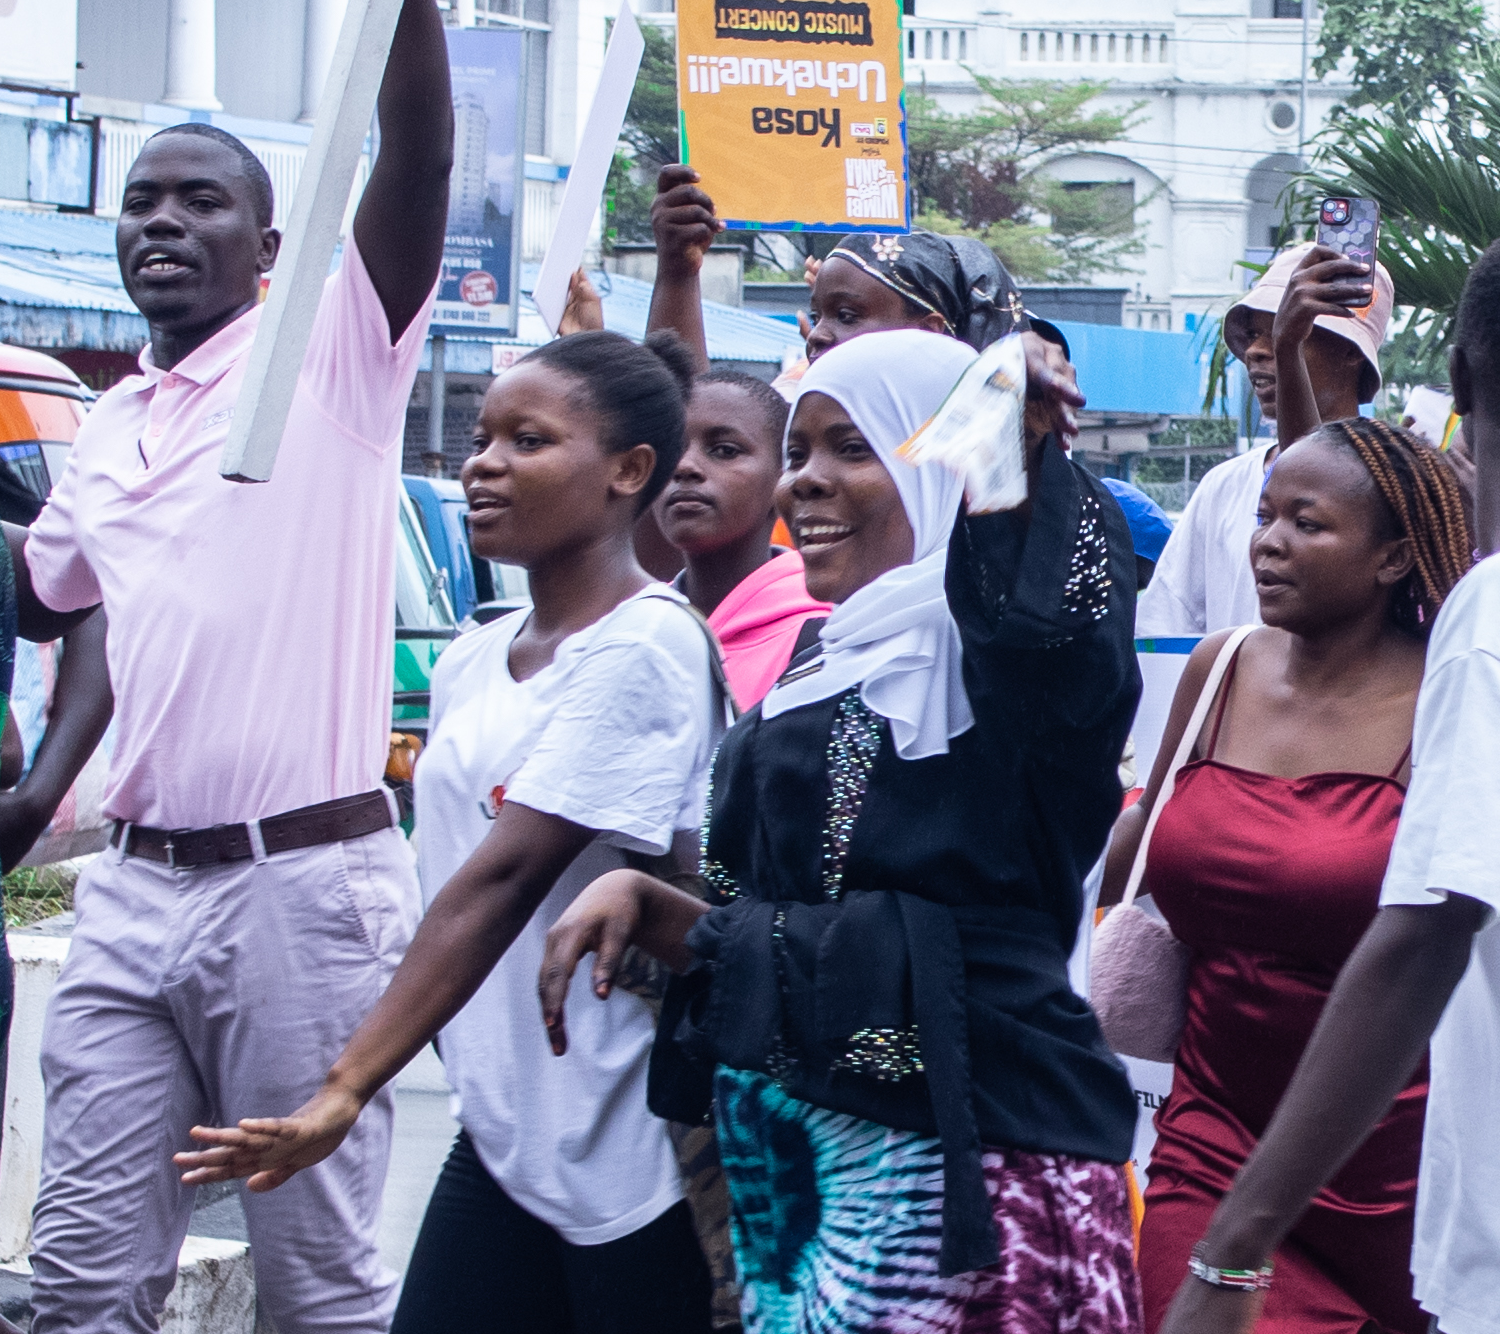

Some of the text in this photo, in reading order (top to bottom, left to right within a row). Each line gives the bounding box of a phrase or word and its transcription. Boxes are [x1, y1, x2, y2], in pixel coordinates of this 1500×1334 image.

[717, 8, 864, 35] MUSIC CONCERT
[687, 55, 887, 102] Uchekwe!!!
[752, 107, 841, 148] Kosa
[845, 157, 887, 186] SANAA
[846, 184, 899, 219] WIMBI
